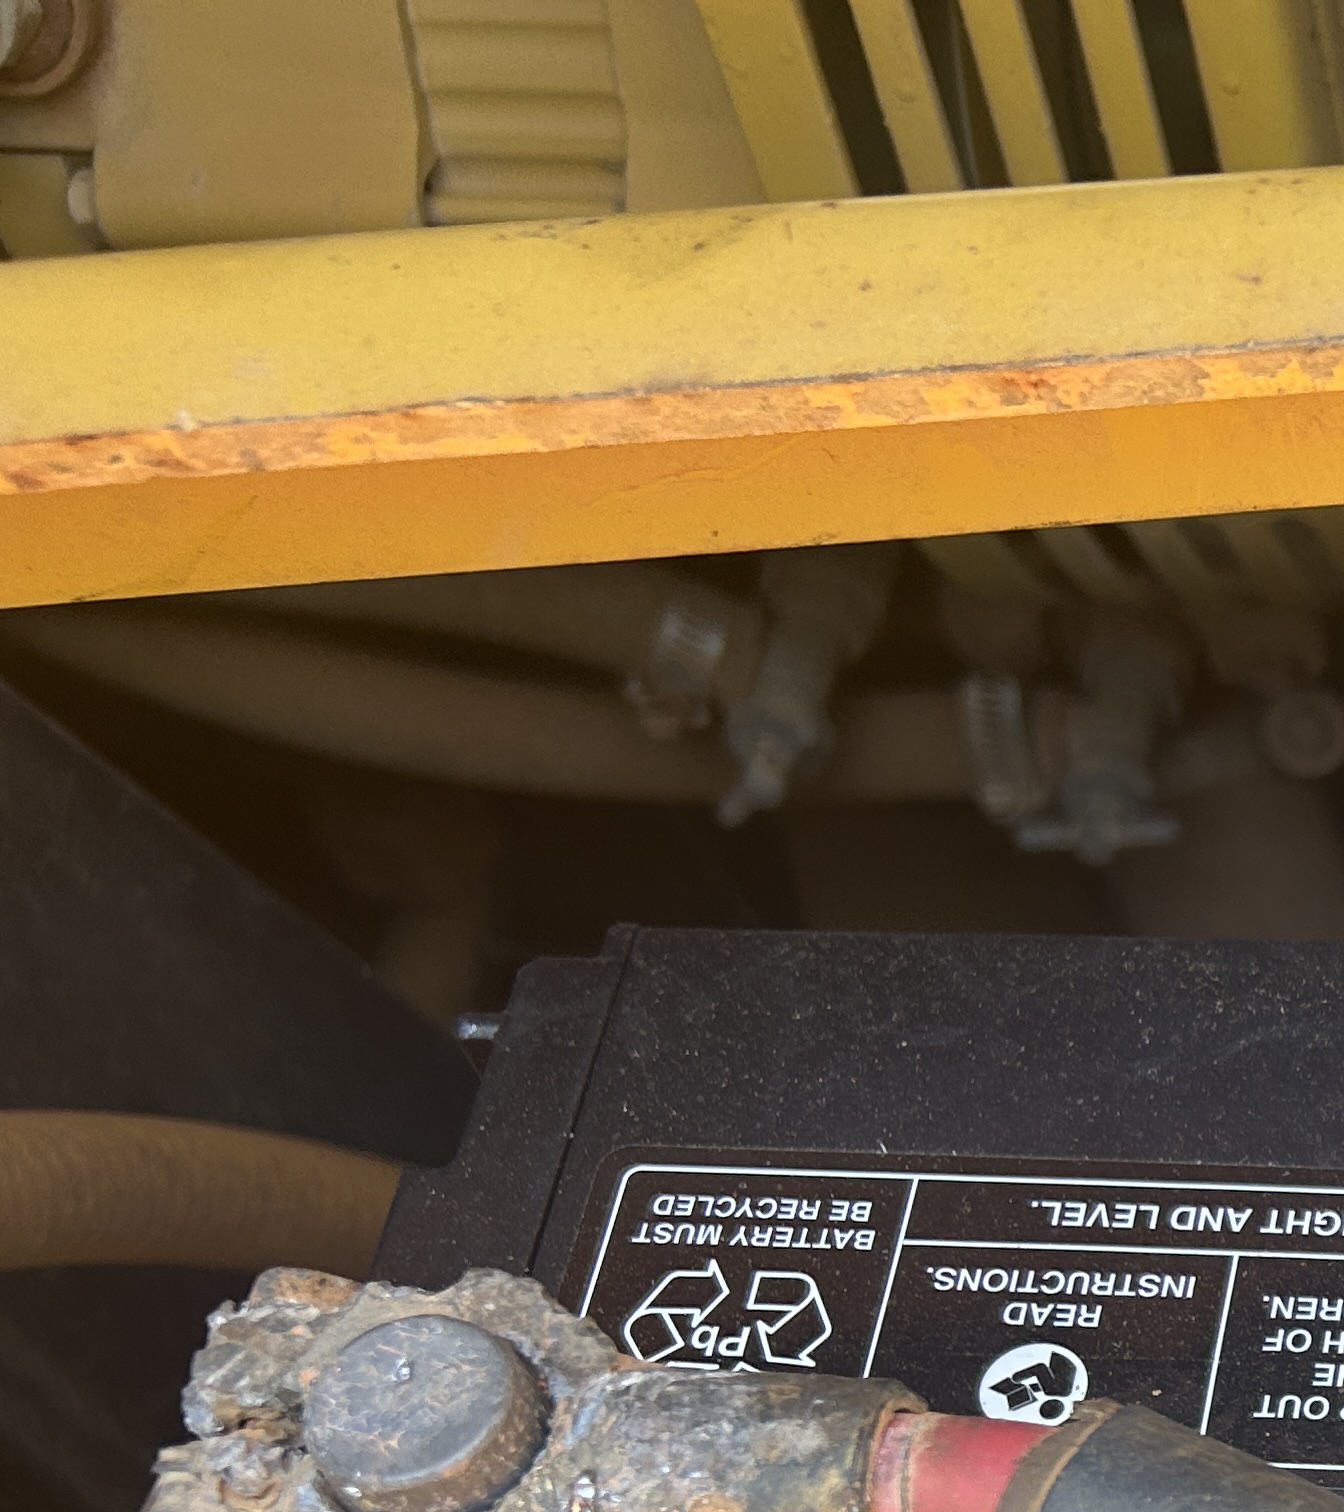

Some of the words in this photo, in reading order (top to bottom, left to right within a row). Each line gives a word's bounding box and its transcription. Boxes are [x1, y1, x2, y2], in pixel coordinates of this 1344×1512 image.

[651, 1191, 823, 1219] RECYCLED
[830, 1199, 873, 1222] BE
[1030, 1199, 1159, 1233] LEVEL.
[631, 1222, 722, 1246] MUST
[1168, 1206, 1253, 1235] AND
[729, 1224, 876, 1250] BATTERY
[926, 1266, 1197, 1300] INSTRUCTIONS.
[1003, 1301, 1103, 1328] READ
[692, 1326, 751, 1357] Pb
[1262, 1328, 1312, 1356] OF
[1253, 1392, 1331, 1420] OUT
